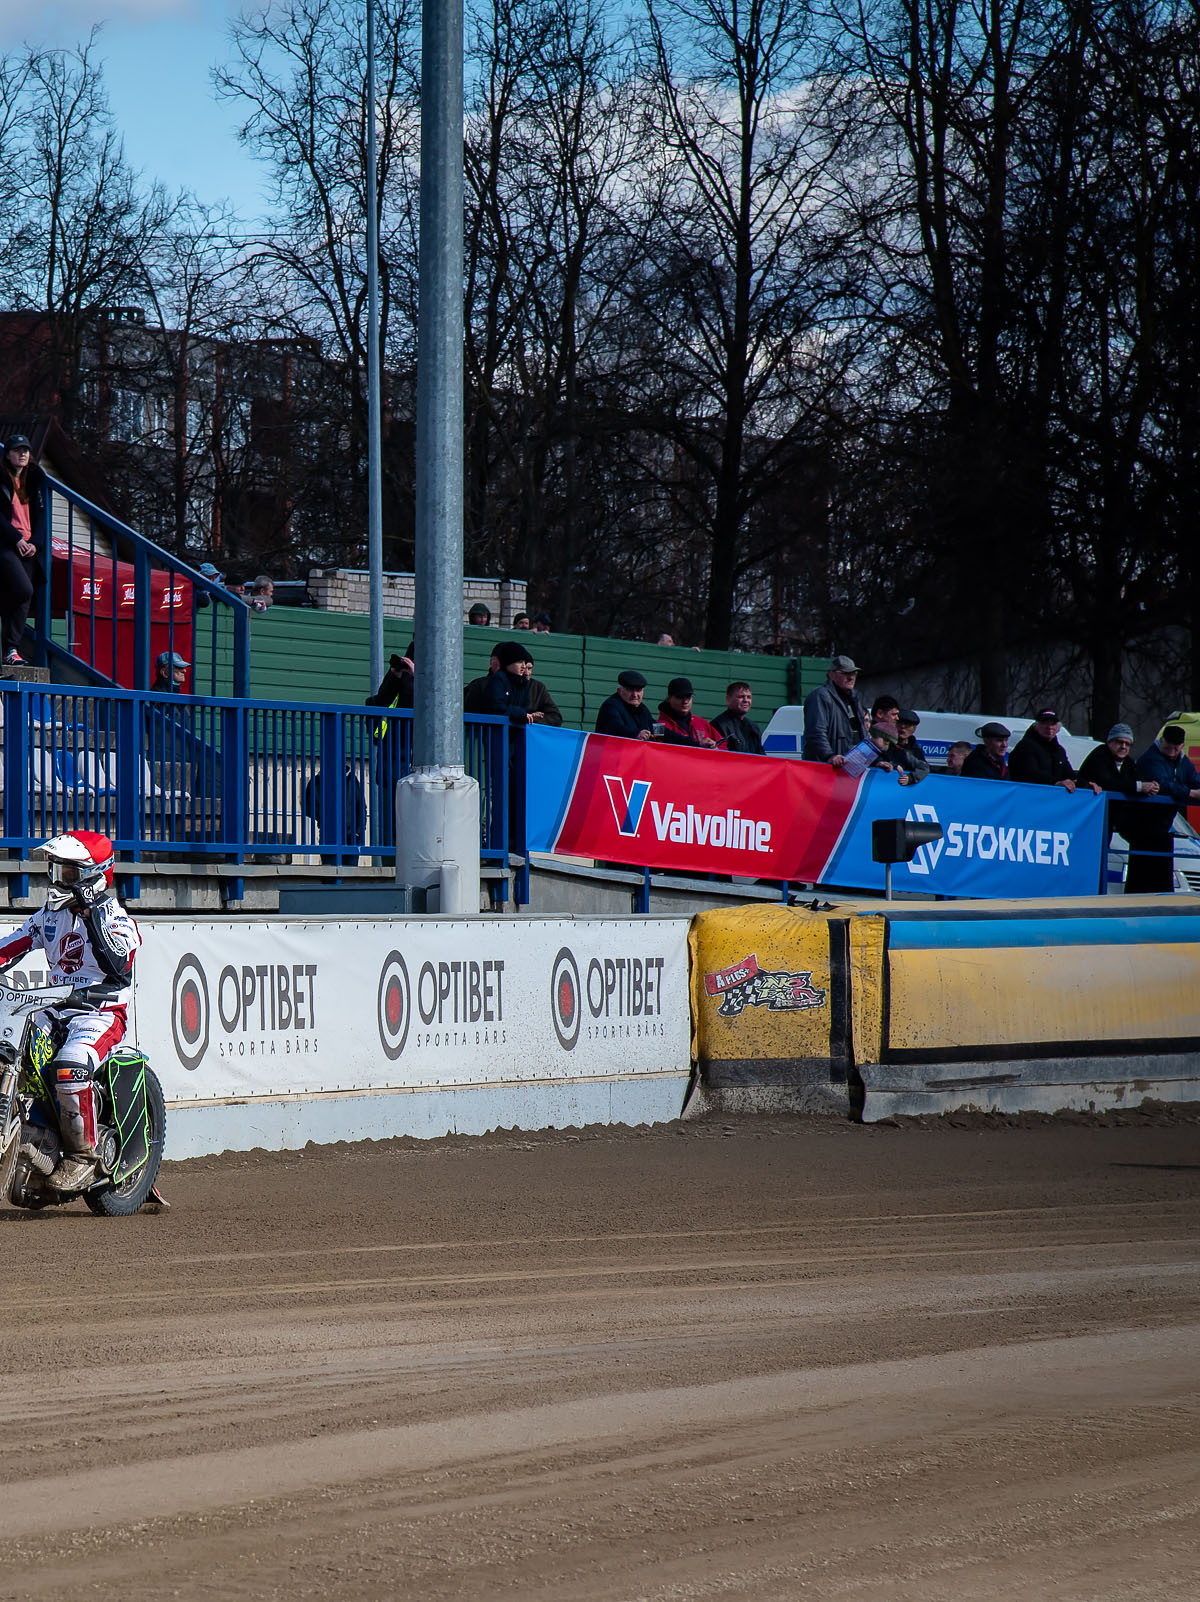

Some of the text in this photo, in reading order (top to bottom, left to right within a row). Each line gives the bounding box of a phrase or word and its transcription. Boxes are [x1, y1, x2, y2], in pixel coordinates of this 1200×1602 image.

[650, 800, 771, 853] Valvoline
[945, 823, 1070, 867] STOKKER
[6, 992, 43, 1006] OPTIBET
[218, 965, 318, 1034] OPTIBET
[418, 960, 505, 1026] OPTIBET
[587, 958, 665, 1019] OPTIBET
[219, 1035, 318, 1057] SPORTA BĀRS
[417, 1026, 507, 1048] SPORTA BĀRS
[588, 1025, 631, 1040] SPORTA
